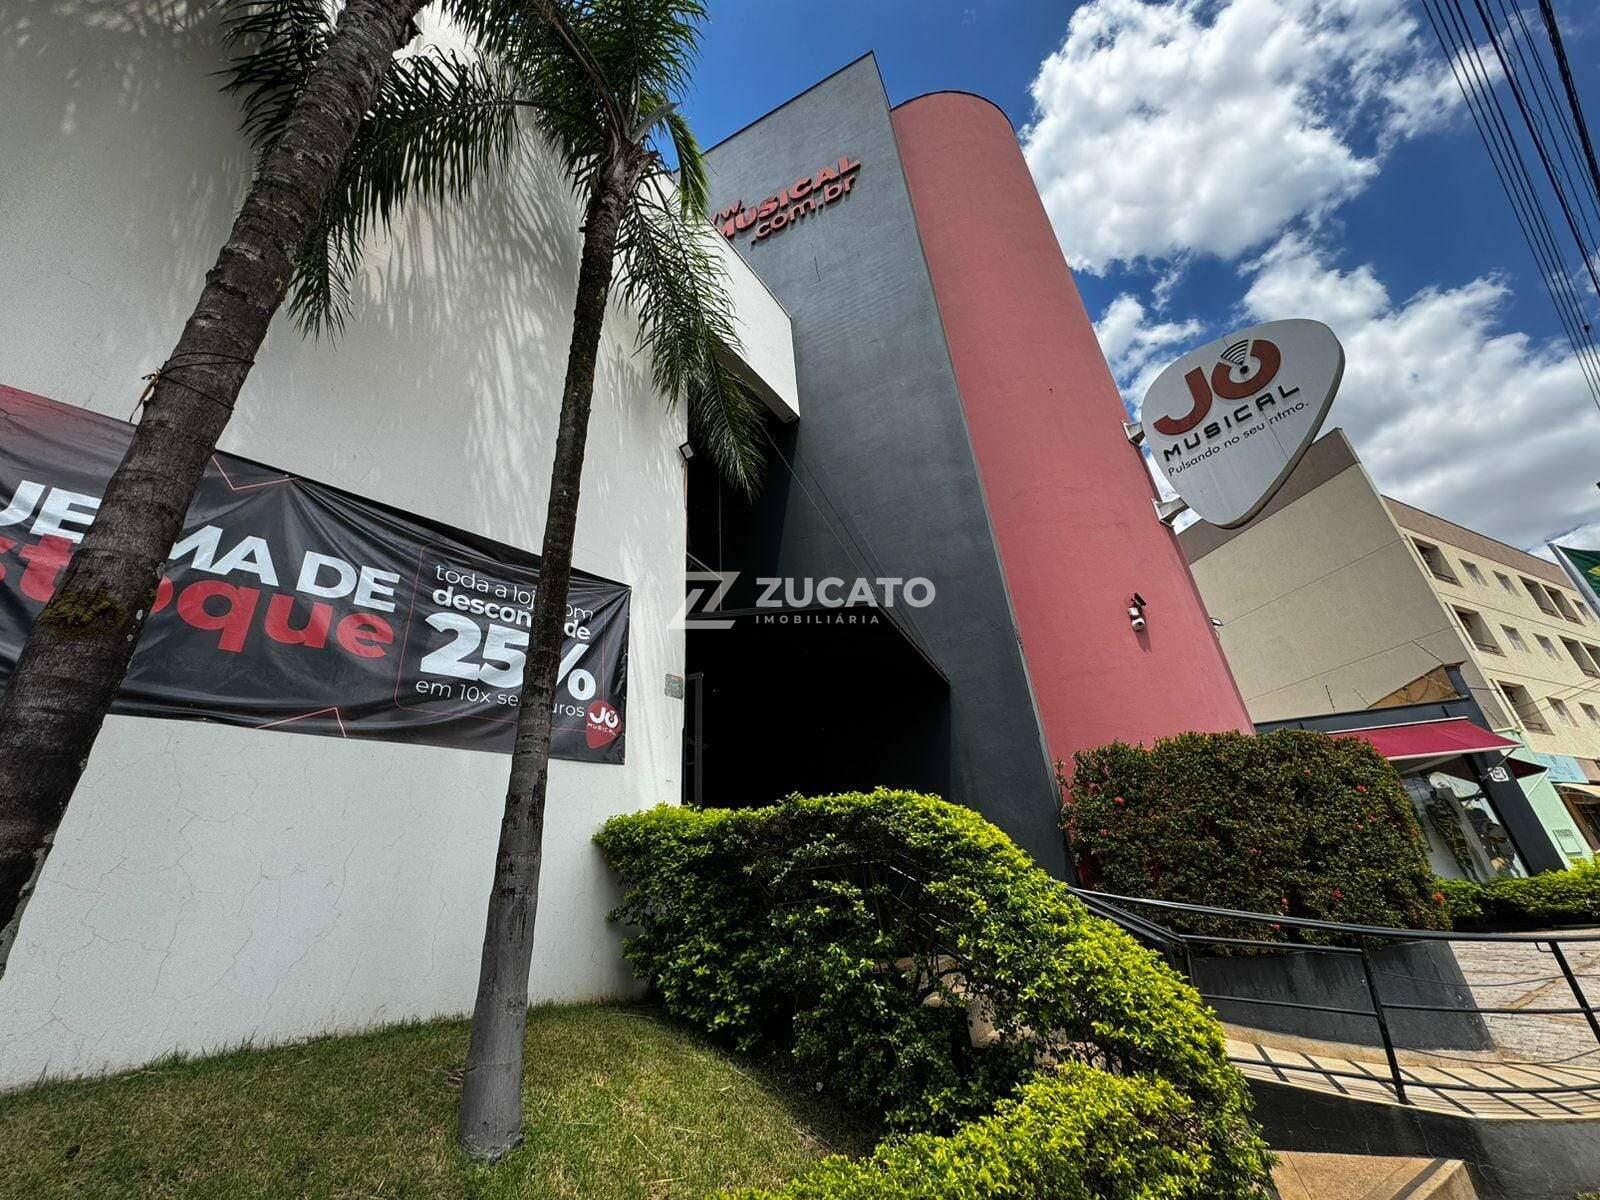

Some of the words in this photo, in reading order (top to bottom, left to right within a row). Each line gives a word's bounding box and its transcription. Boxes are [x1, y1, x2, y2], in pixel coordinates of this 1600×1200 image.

[750, 174, 856, 245] .com.br
[1163, 384, 1300, 462] MUSICAL
[1167, 446, 1221, 477] Pulsando
[1224, 435, 1240, 449] no
[1243, 422, 1265, 438] seu
[1268, 401, 1310, 425] ritmo.
[296, 551, 400, 613] DE
[432, 586, 533, 628] descon
[564, 619, 591, 640] de
[435, 564, 489, 594] toda
[495, 584, 507, 599] a
[513, 585, 536, 610] loj
[566, 604, 593, 621] om
[420, 612, 597, 701] 25%
[415, 680, 451, 698] em
[460, 684, 492, 704] 10x
[497, 692, 519, 707] se
[587, 722, 617, 737] MUSICAL
